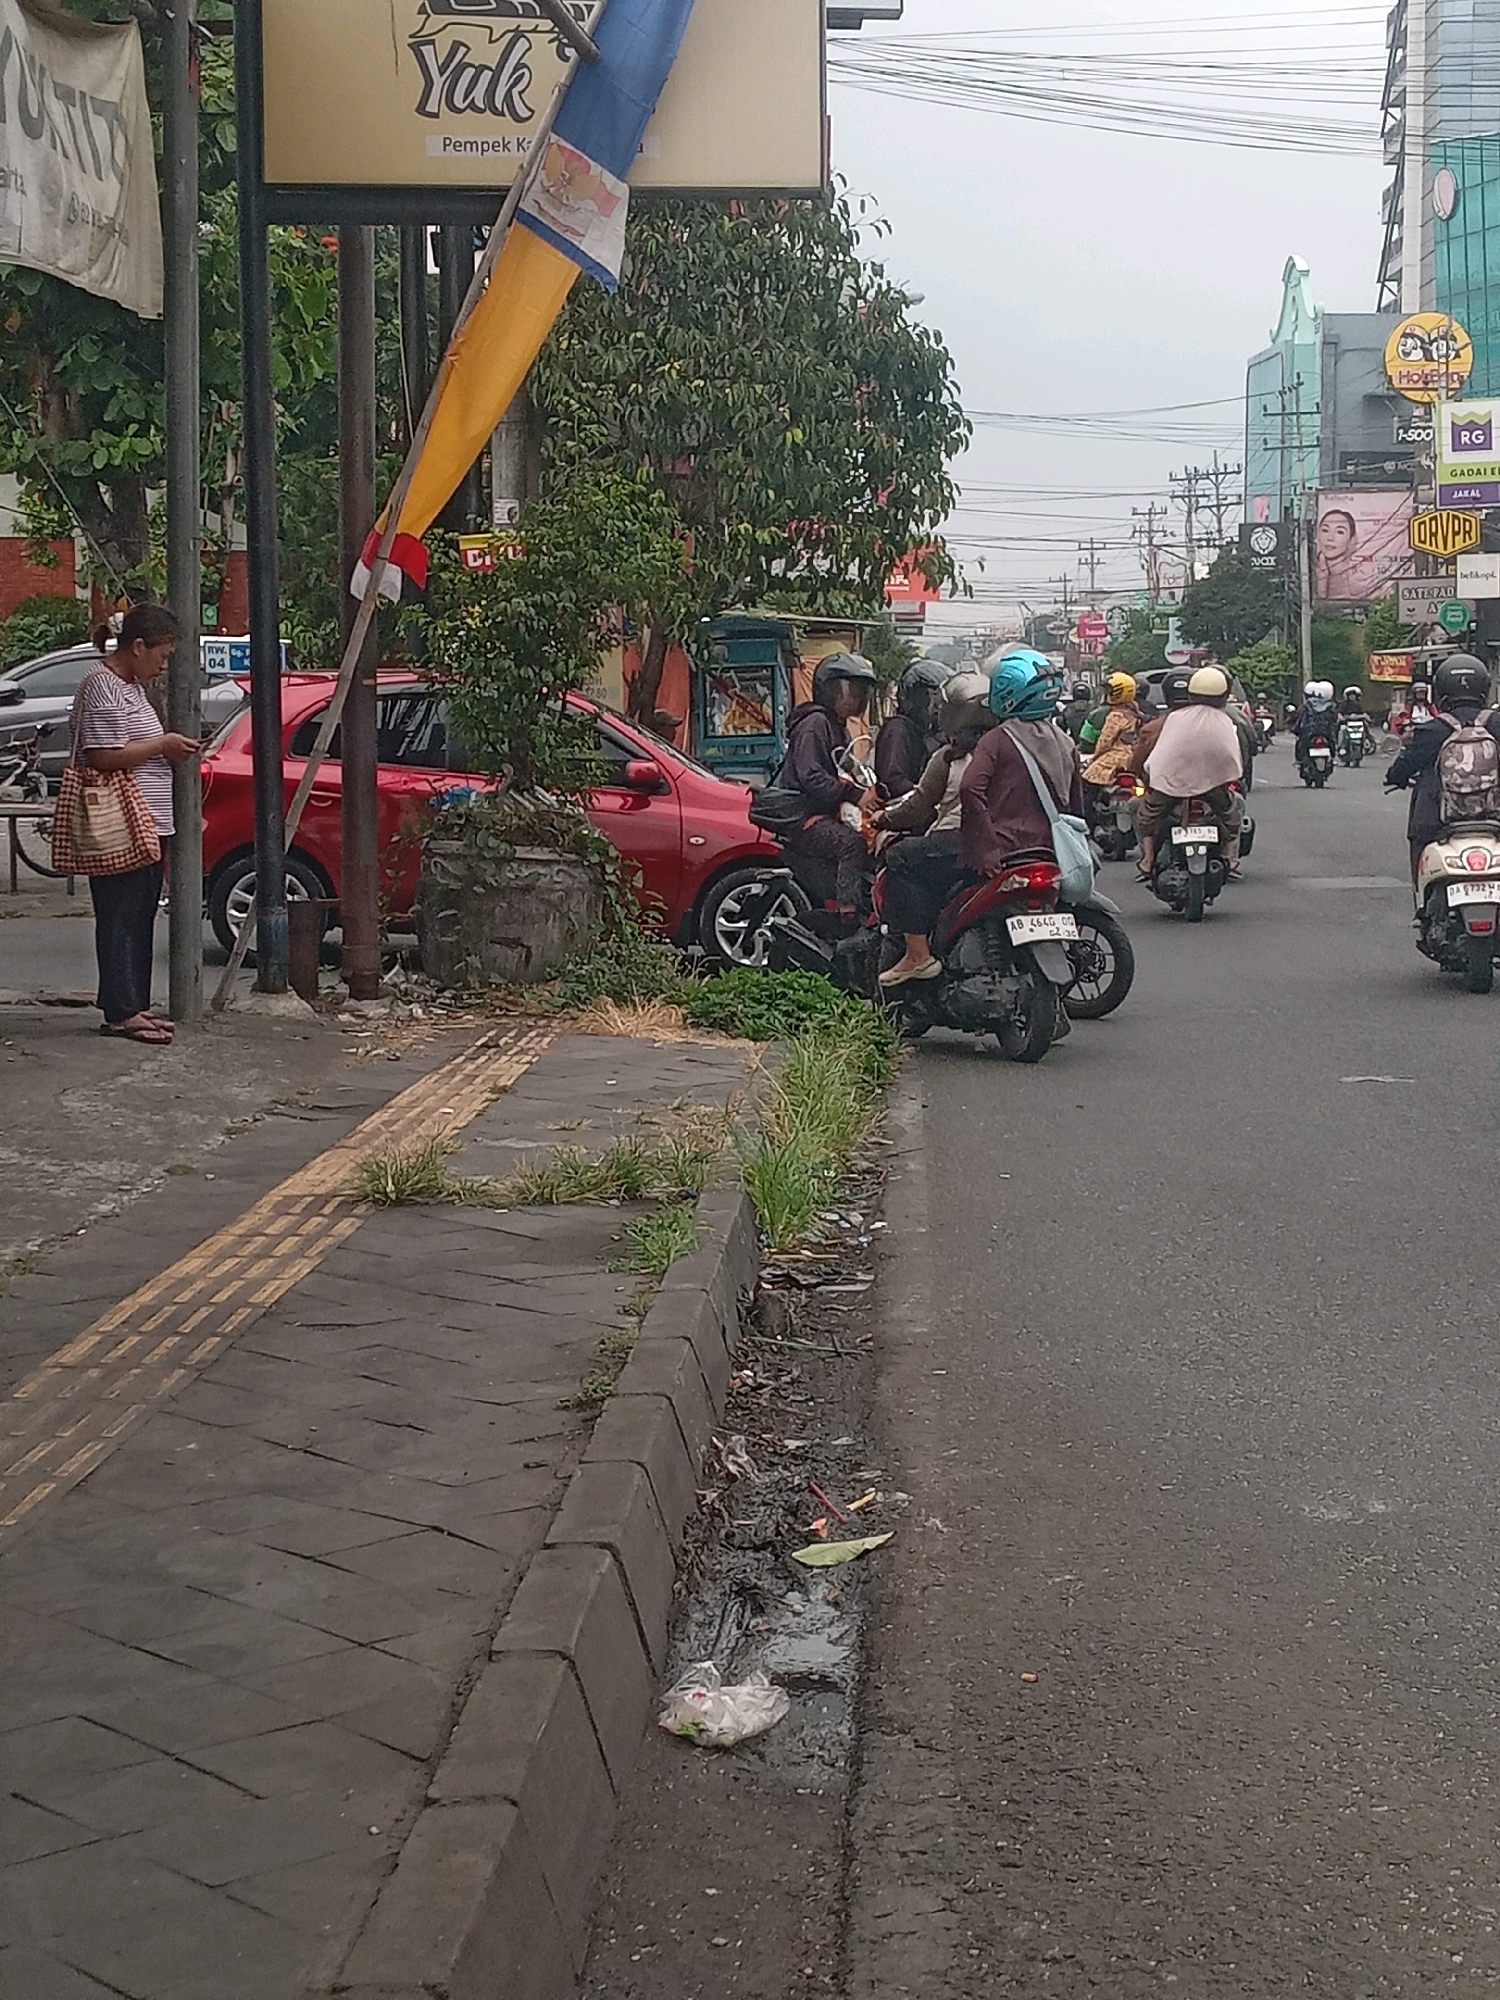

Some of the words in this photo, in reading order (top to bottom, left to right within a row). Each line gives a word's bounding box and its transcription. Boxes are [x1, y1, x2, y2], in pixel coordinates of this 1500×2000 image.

[408, 32, 535, 124] Yuk
[442, 137, 511, 156] Pempek
[1460, 430, 1485, 445] RG
[1449, 467, 1487, 478] GADAI
[1402, 588, 1429, 599] SATE
[207, 645, 228, 655] RW.
[208, 657, 226, 669] 04
[1010, 918, 1024, 932] AB
